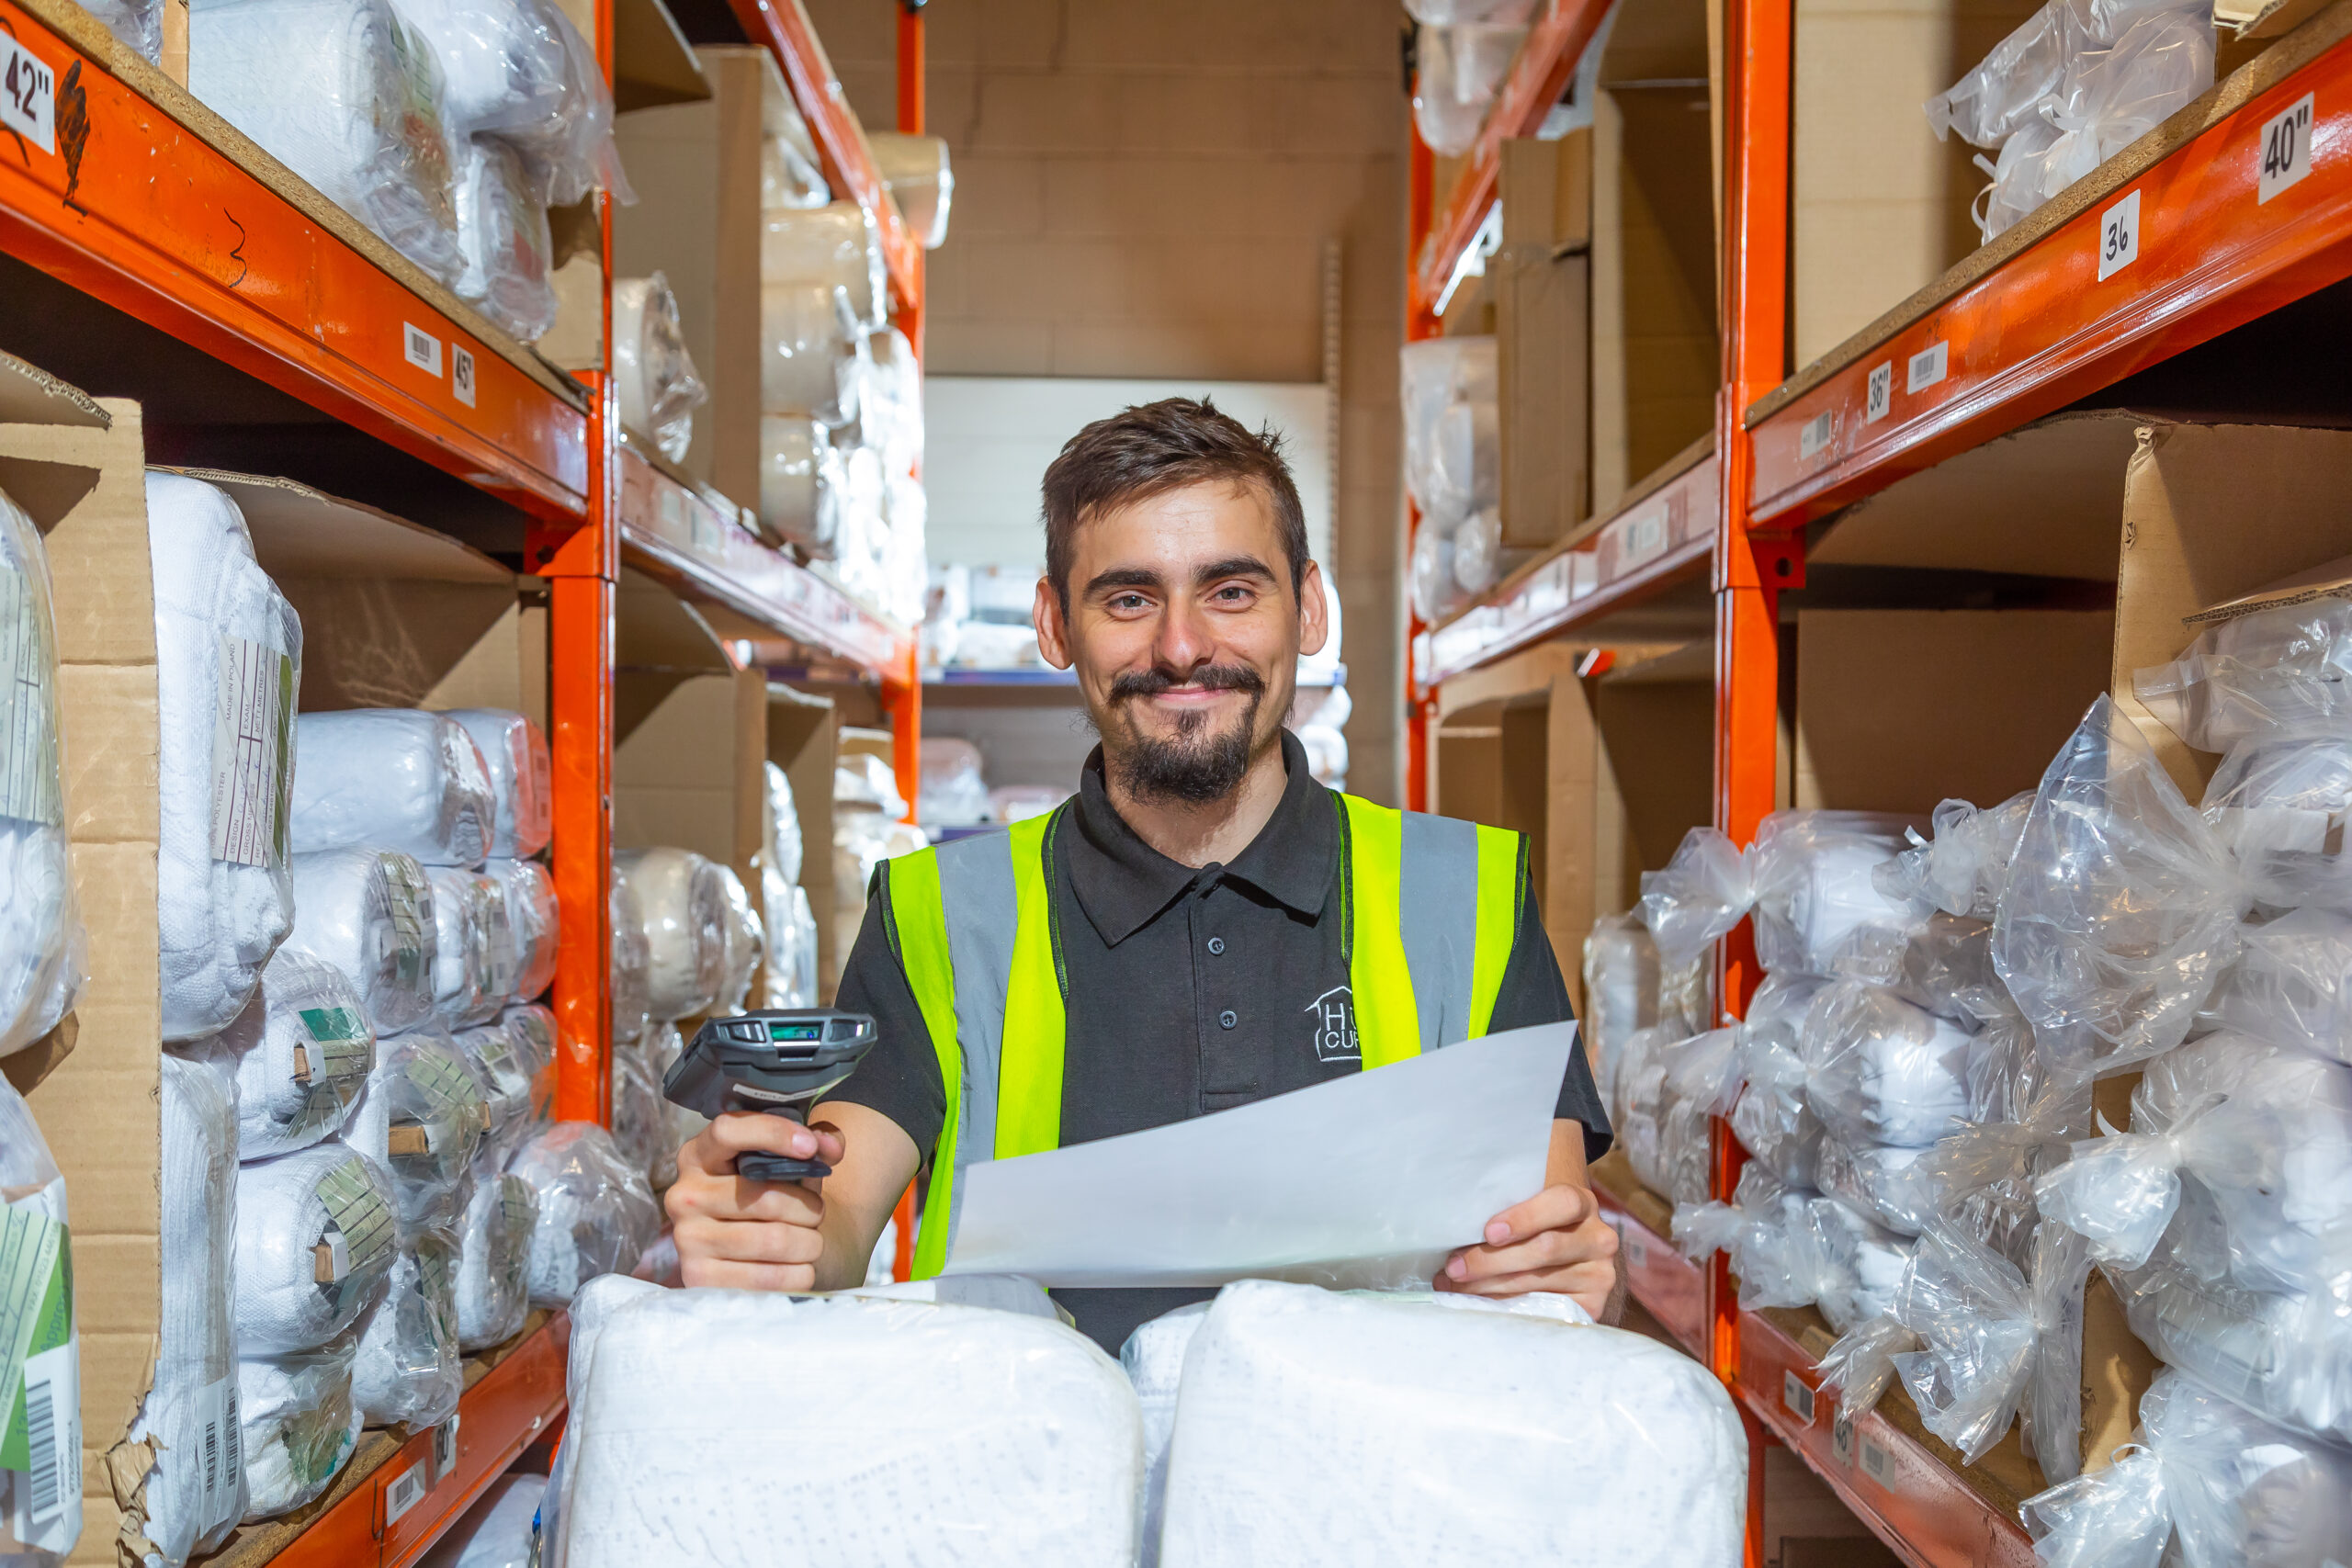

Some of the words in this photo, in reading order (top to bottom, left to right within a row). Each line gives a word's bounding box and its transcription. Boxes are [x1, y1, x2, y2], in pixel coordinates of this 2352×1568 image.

[6, 50, 49, 122] 42"
[2265, 104, 2309, 179] 40"
[2106, 215, 2128, 261] 36
[455, 350, 472, 390] 45"
[1870, 368, 1889, 412] 36"
[228, 682, 233, 693] IN
[213, 772, 226, 825] POLYESTER
[230, 819, 239, 854] DESIGN
[243, 827, 251, 855] GROSS
